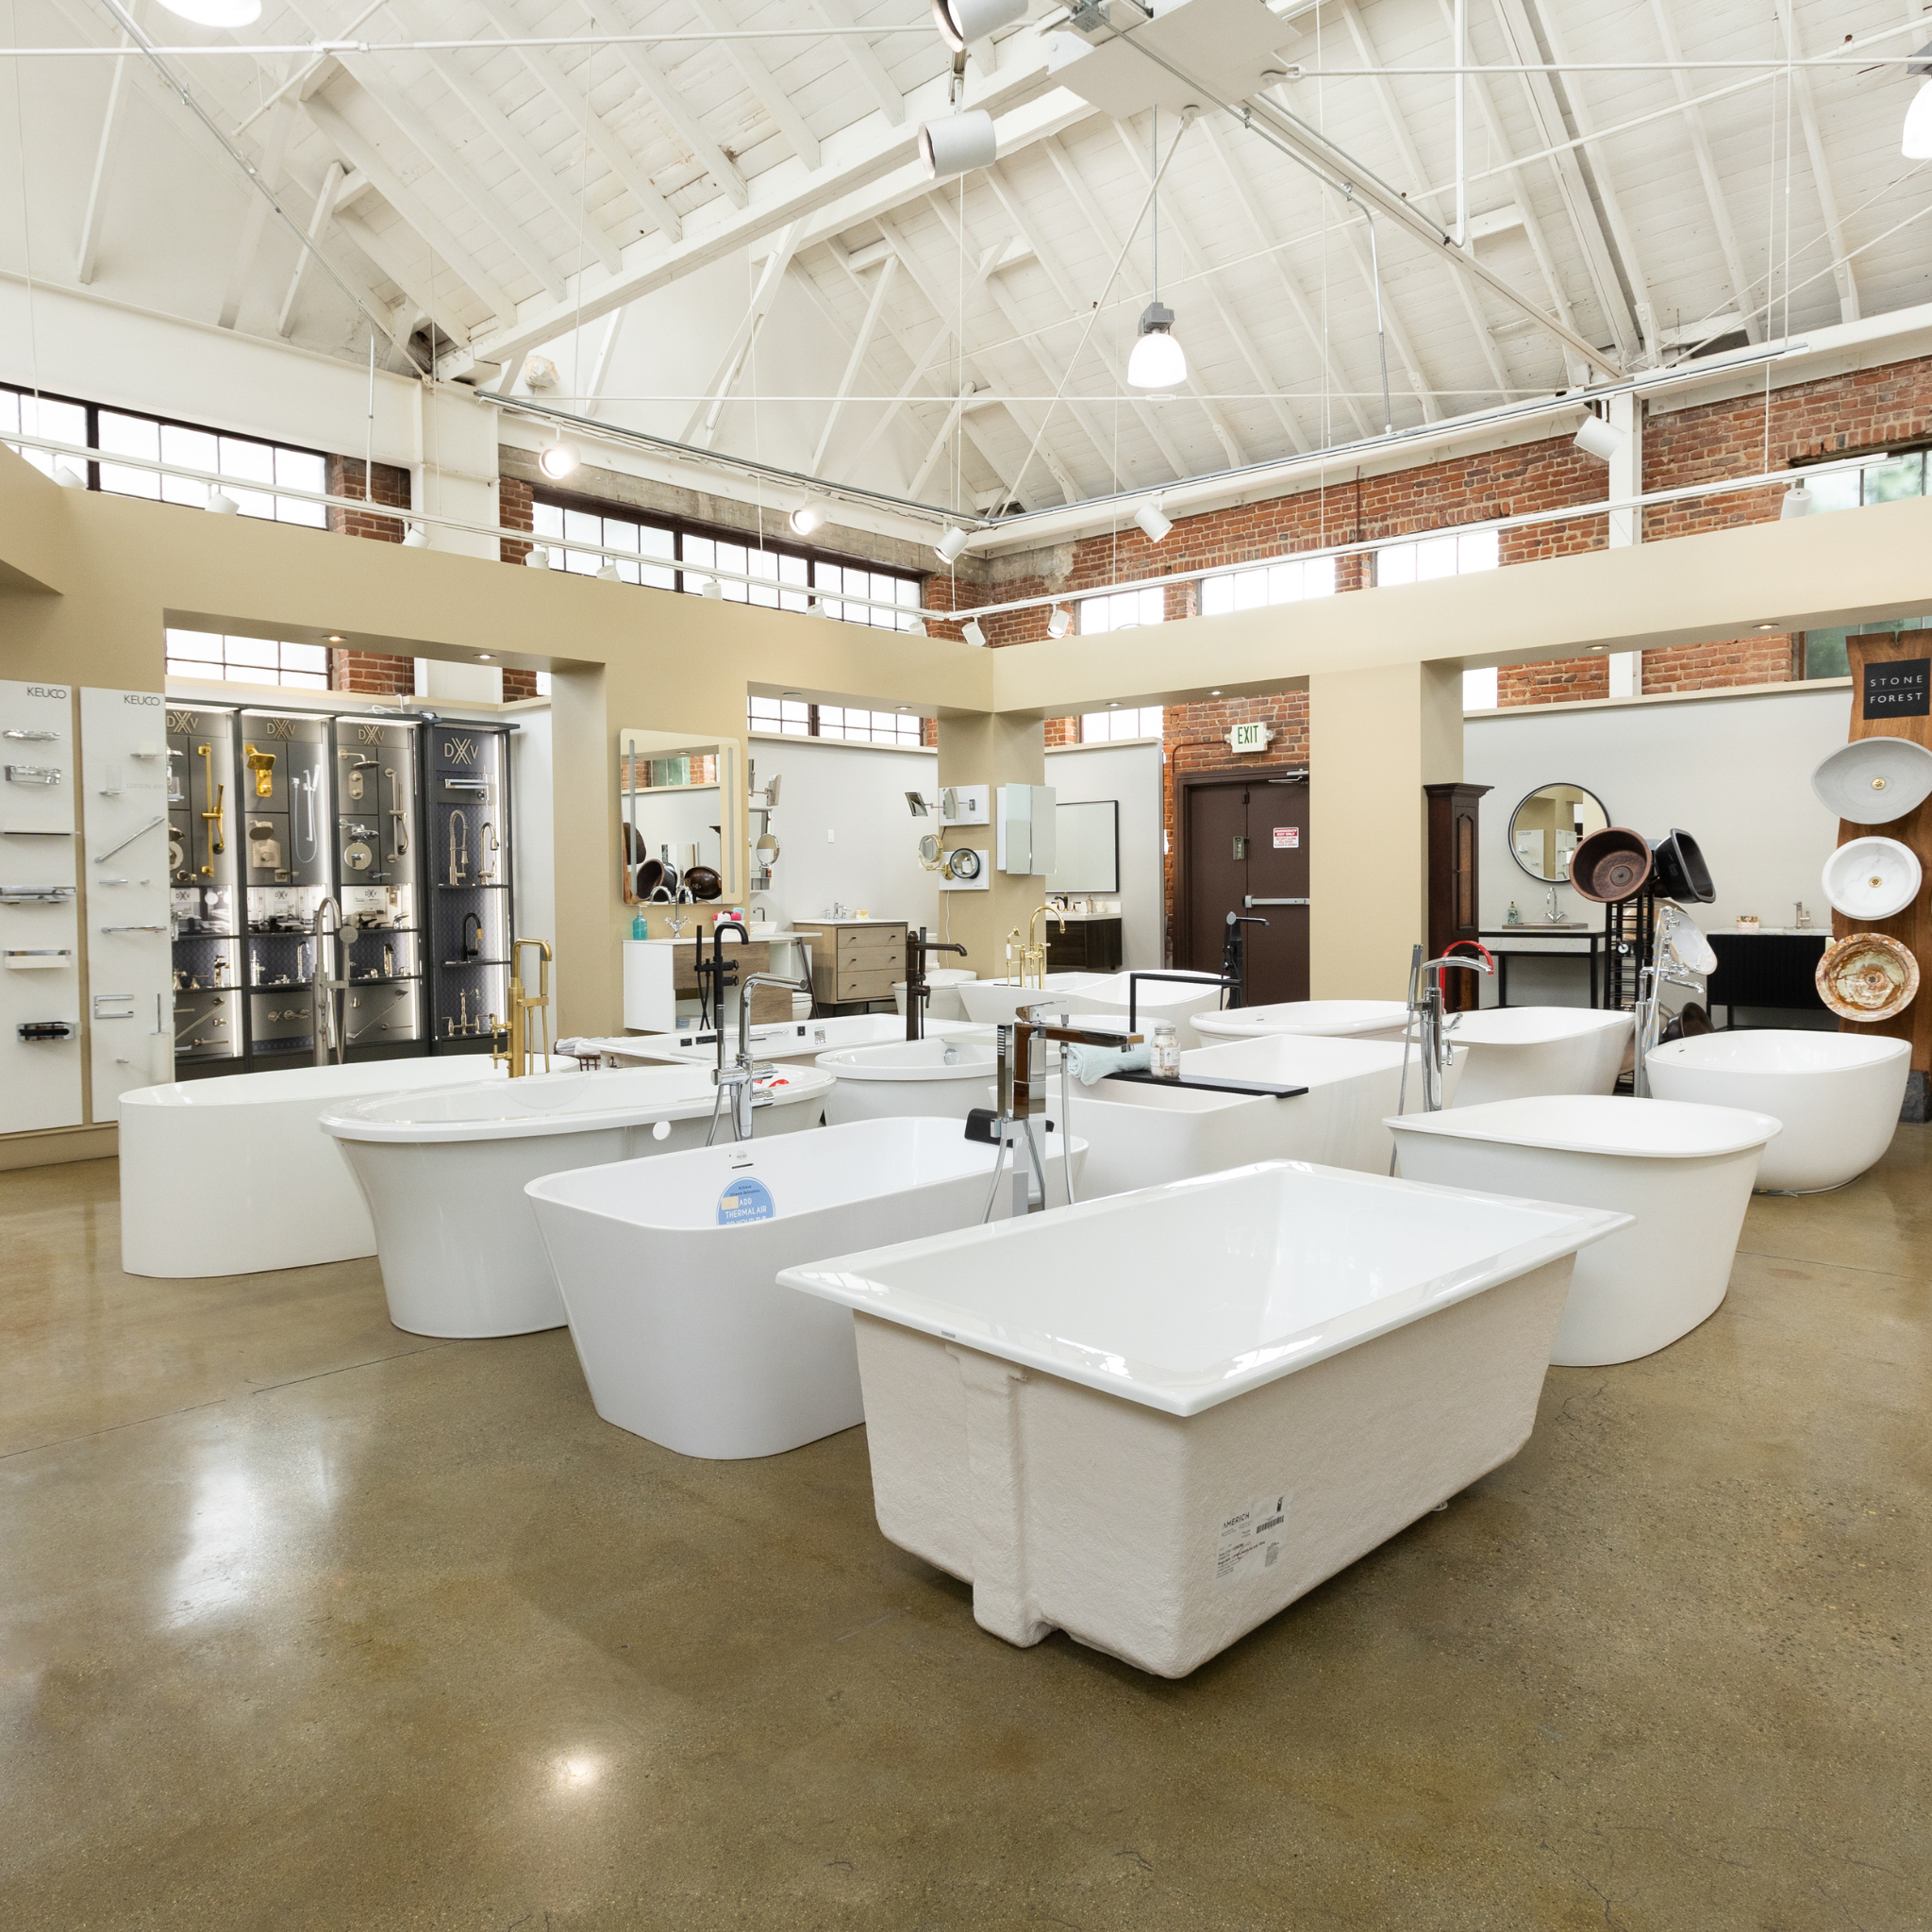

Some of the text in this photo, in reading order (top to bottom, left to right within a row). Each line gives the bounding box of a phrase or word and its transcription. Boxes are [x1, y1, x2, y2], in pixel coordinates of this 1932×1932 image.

[1870, 675, 1923, 687] STONE
[27, 687, 67, 700] KEUCO
[1870, 692, 1923, 704] FOREST
[124, 694, 160, 707] KEUCO
[166, 711, 198, 734] DXV
[266, 719, 296, 740] DXV
[358, 724, 385, 746] DXV
[1237, 724, 1259, 744] EXIT
[443, 737, 479, 765] DXV
[175, 891, 191, 901] DXV
[275, 890, 288, 900] DXV
[365, 889, 377, 898] DXV
[1222, 1511, 1250, 1529] AMERICH
